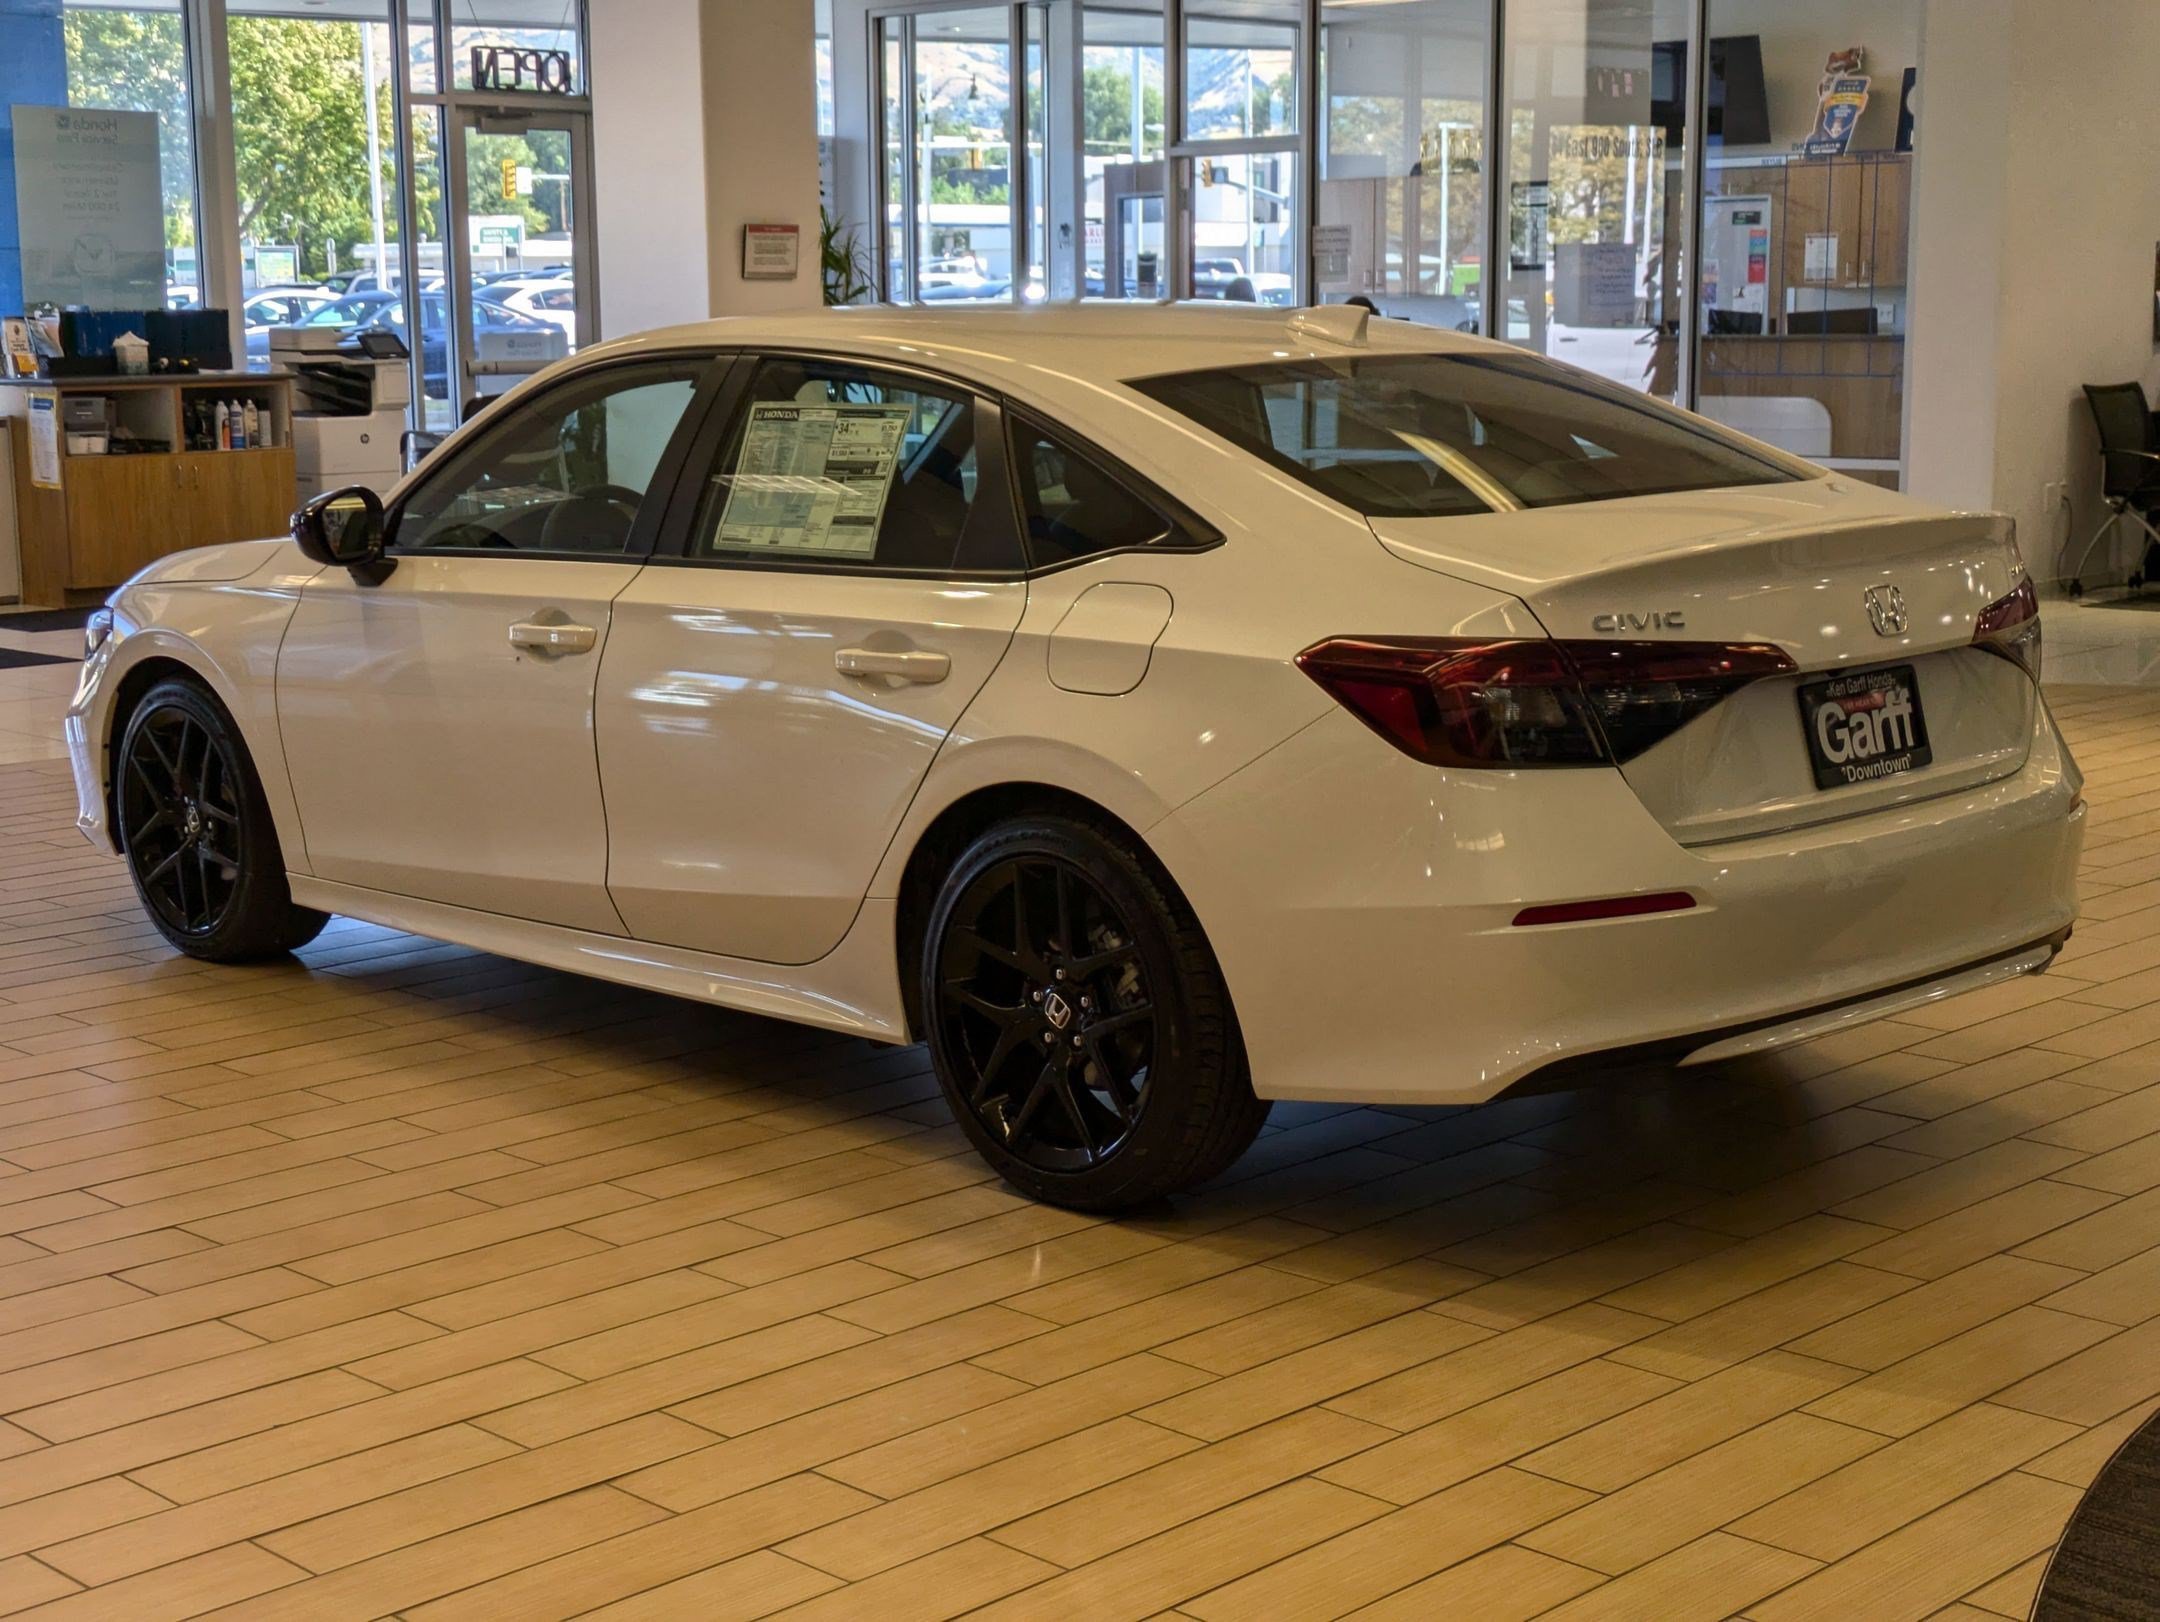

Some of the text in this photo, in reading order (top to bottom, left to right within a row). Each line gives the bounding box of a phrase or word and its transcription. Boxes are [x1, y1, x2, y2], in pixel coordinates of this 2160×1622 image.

[764, 411, 798, 419] HONDA
[838, 423, 849, 434] 34
[1592, 611, 1685, 632] CIVIC
[1830, 672, 1892, 697] Ken Garff Honda
[1817, 688, 1914, 764] Garff
